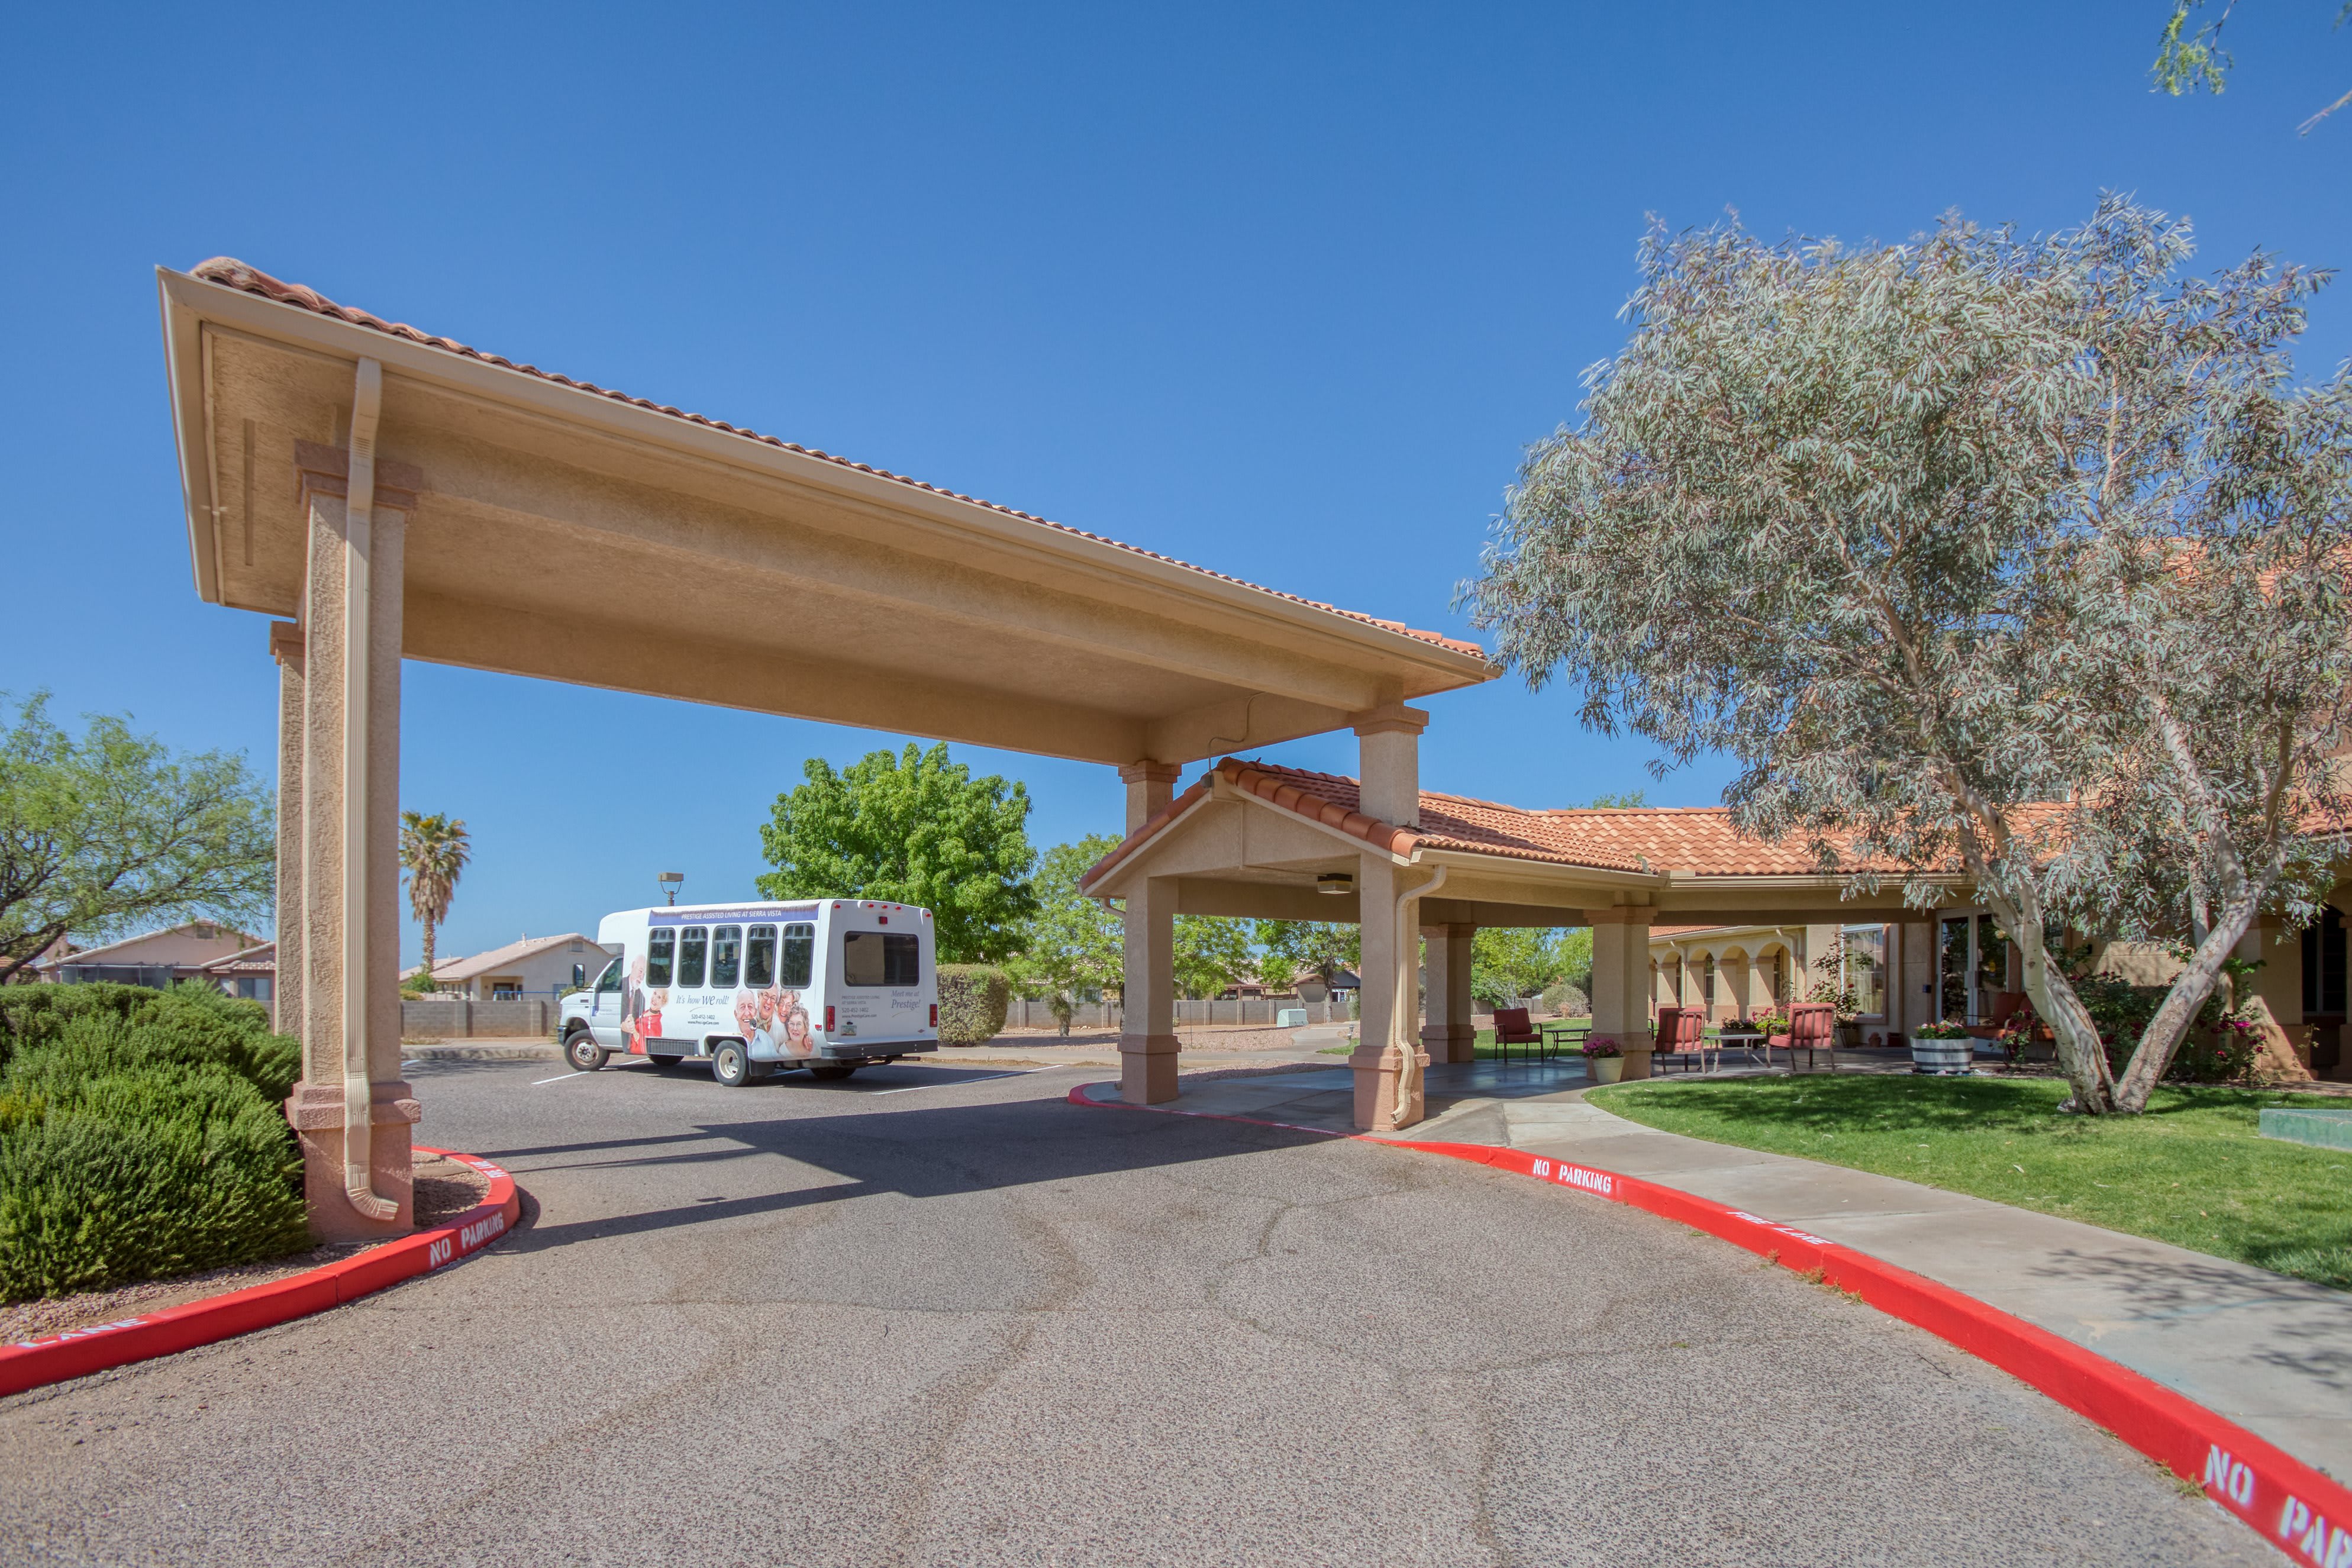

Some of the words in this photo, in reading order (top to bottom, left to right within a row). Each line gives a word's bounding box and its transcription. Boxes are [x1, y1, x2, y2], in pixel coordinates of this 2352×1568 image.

[676, 995, 685, 1004] It's
[688, 995, 701, 1004] how
[716, 995, 729, 1005] roll!
[891, 999, 921, 1011] Prestige!
[1532, 1159, 1550, 1176] NO
[1559, 1164, 1611, 1193] PARKING
[430, 1238, 451, 1267] NO
[461, 1212, 504, 1250] PARKING
[1726, 1212, 1775, 1224] FIRE
[1773, 1228, 1833, 1245] LANE
[18, 1318, 148, 1348] LANE
[2204, 1444, 2253, 1506] NO
